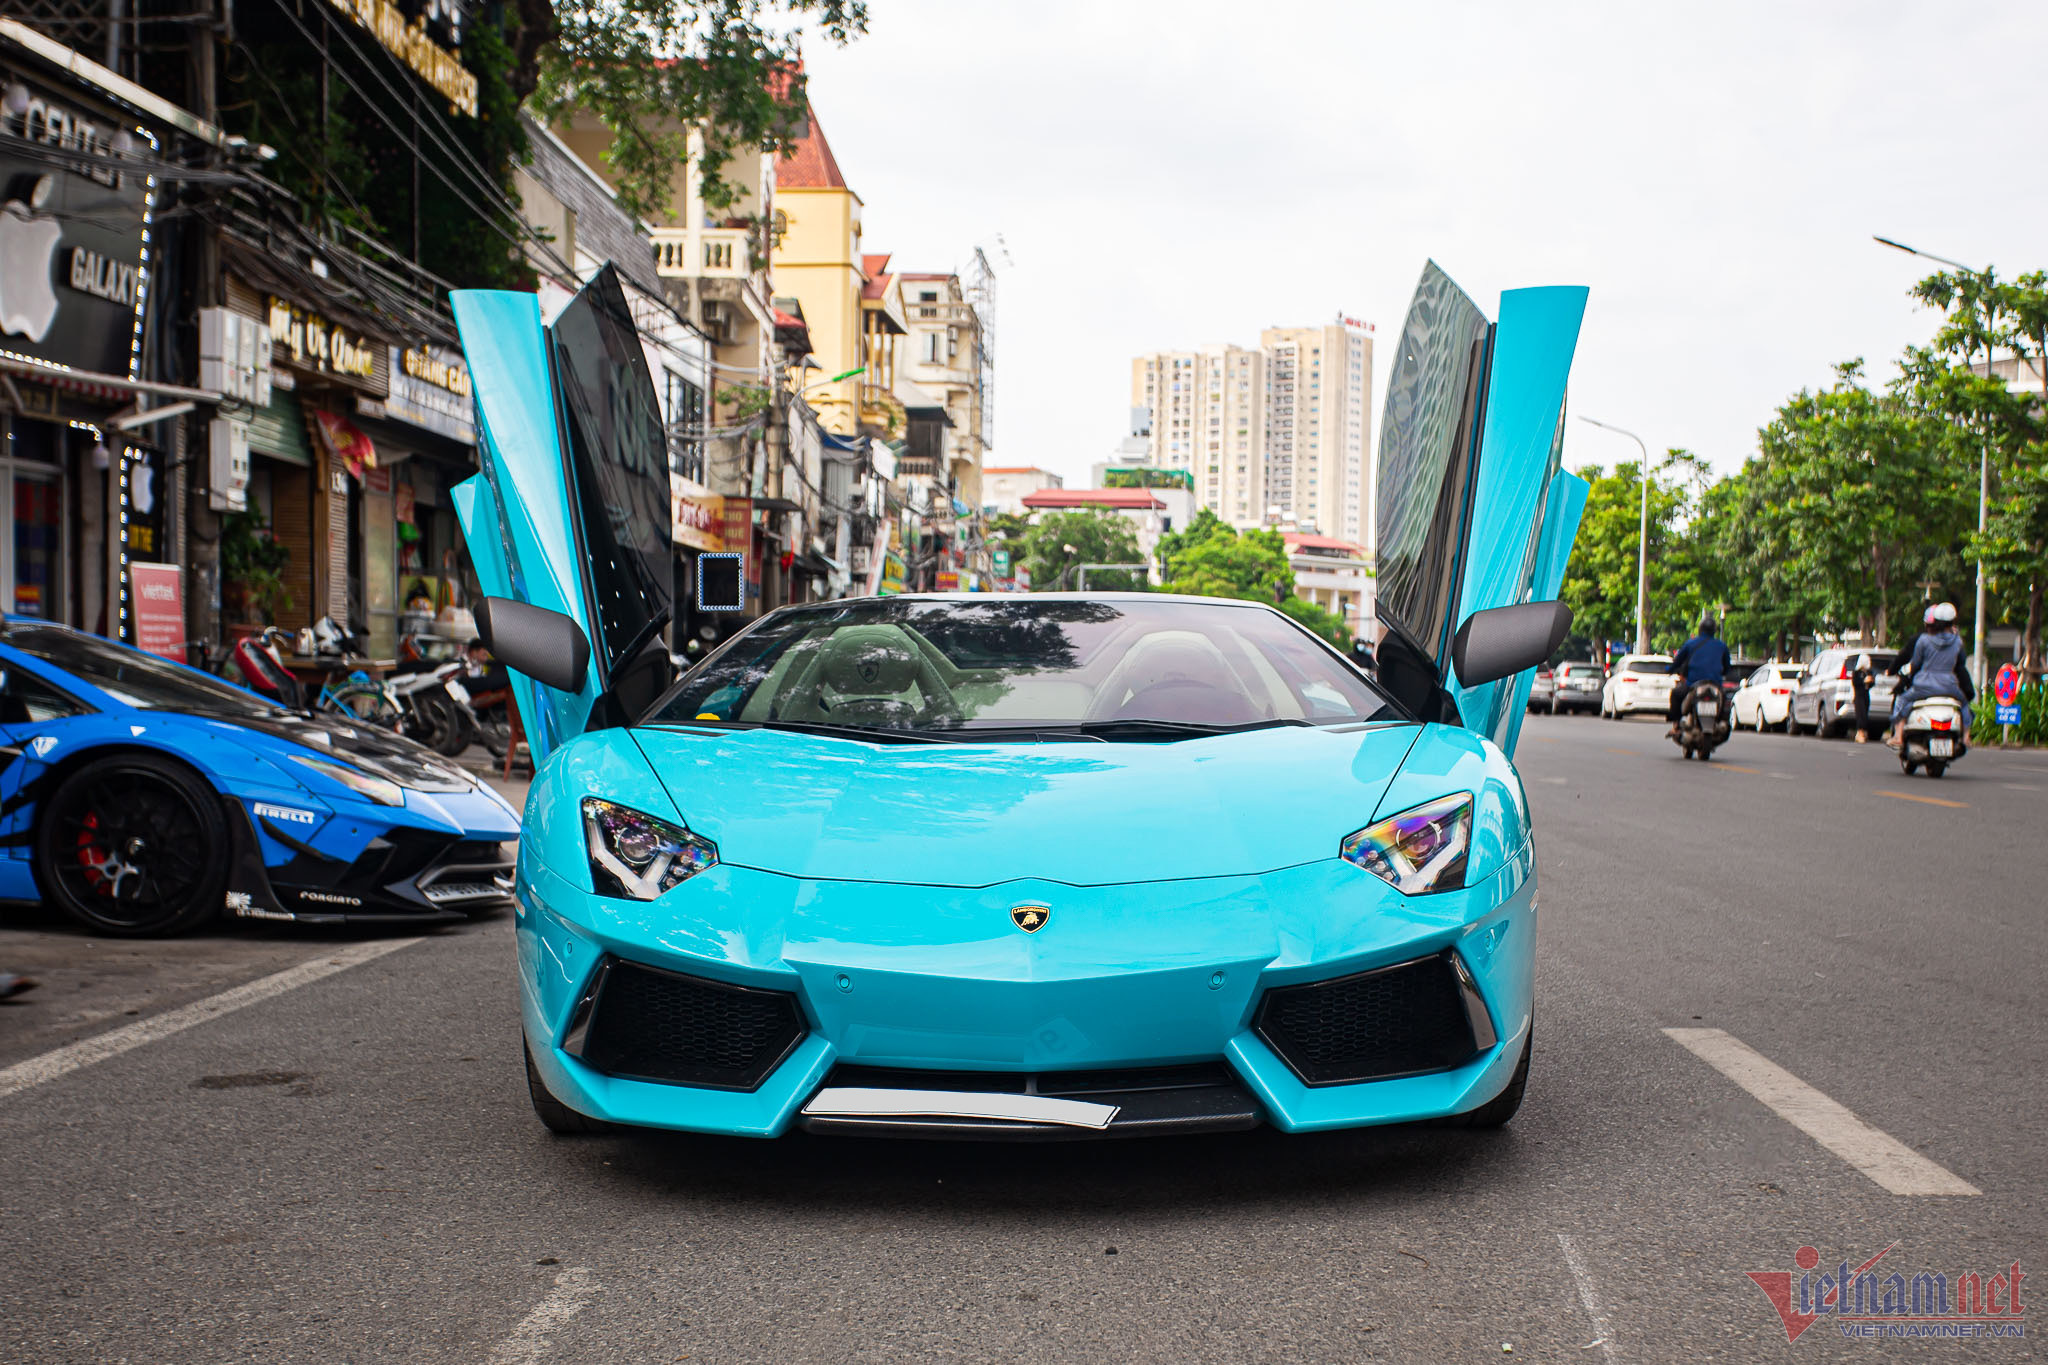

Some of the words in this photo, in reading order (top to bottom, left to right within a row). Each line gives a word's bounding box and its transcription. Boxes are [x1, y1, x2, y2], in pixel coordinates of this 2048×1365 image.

[25, 97, 128, 158] CENTE
[71, 245, 148, 306] GALAXY
[253, 802, 314, 824] PIRELLI
